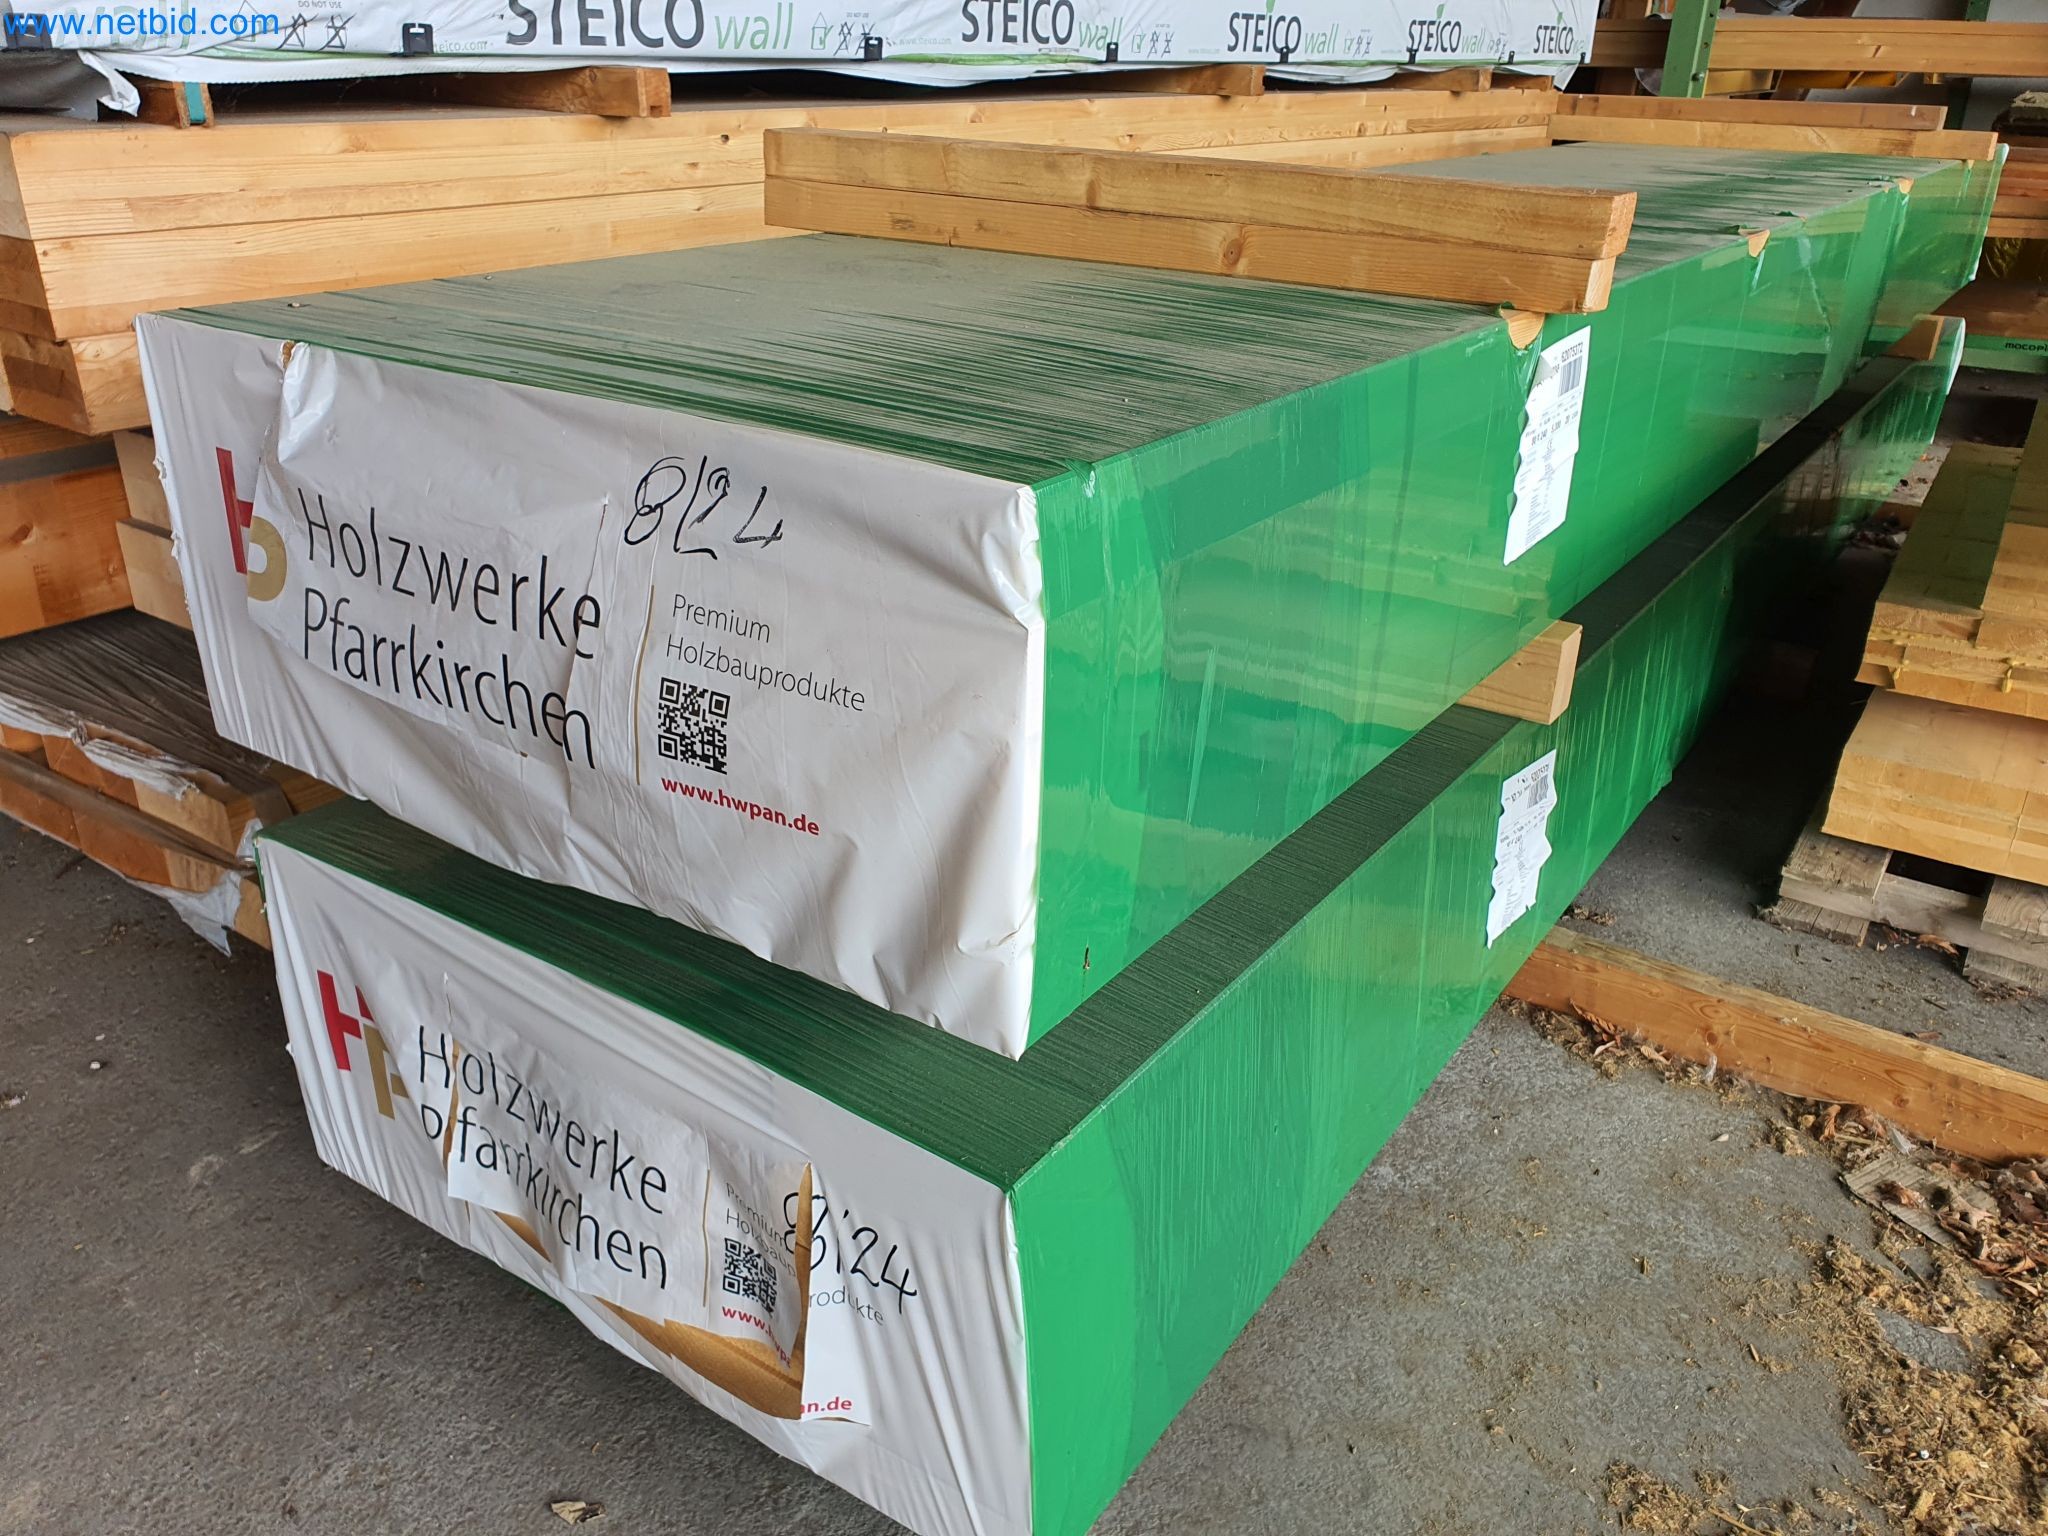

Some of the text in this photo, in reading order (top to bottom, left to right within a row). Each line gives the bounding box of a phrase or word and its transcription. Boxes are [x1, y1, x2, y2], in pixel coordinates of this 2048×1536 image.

[714, 2, 794, 50] wall
[961, 0, 1124, 51] STEICO wall
[1227, 12, 1340, 55] STEICO wall
[1406, 19, 1486, 55] STEICO wall
[1533, 25, 1574, 54] STEICO
[297, 487, 601, 660] Holzwerke
[672, 593, 771, 643] Premium
[304, 586, 596, 770] Pfarrkirchen
[666, 634, 866, 712] Holzbauprodukte
[661, 777, 820, 836] www.hwpan.de
[418, 1025, 668, 1215] Holzwerke
